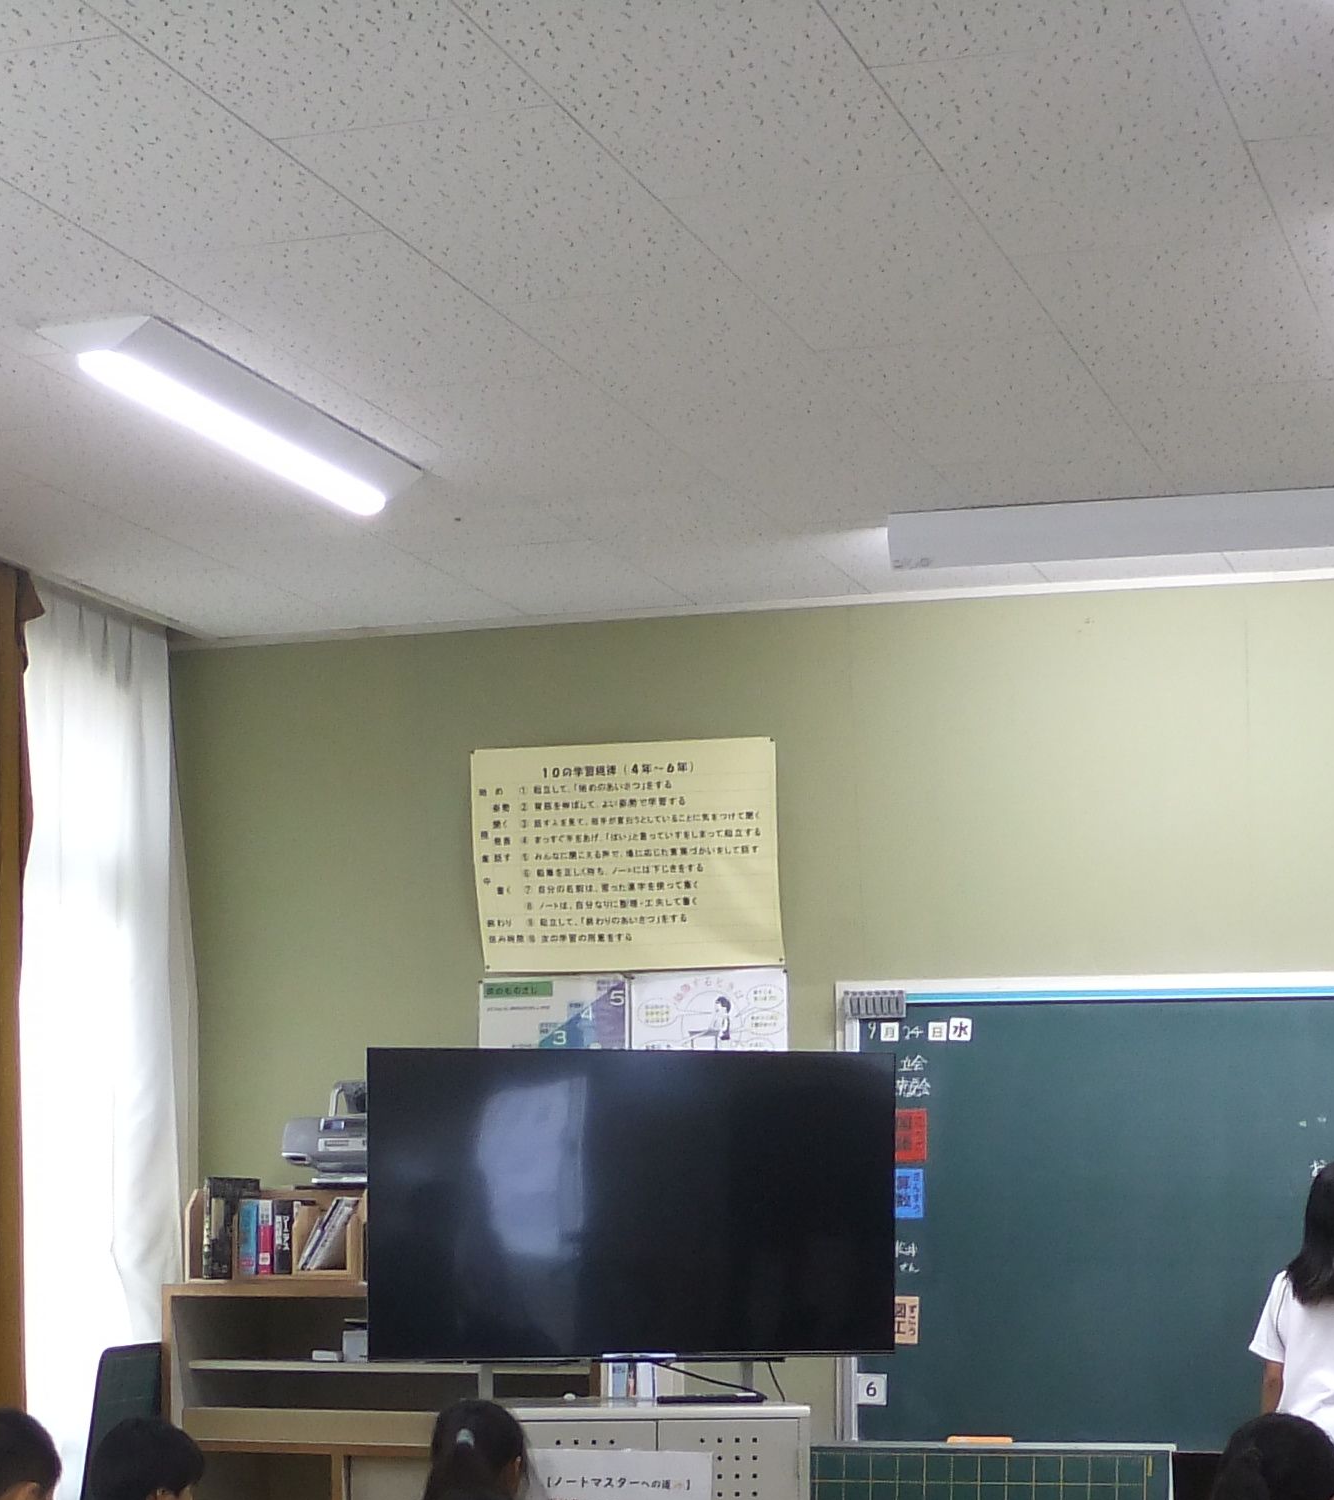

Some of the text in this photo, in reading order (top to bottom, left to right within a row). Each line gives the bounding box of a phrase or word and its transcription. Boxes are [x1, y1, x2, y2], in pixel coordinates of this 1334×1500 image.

[609, 990, 624, 1007] 5
[581, 1006, 593, 1021] 4
[552, 1030, 567, 1045] 3
[866, 1381, 877, 1397] 6
